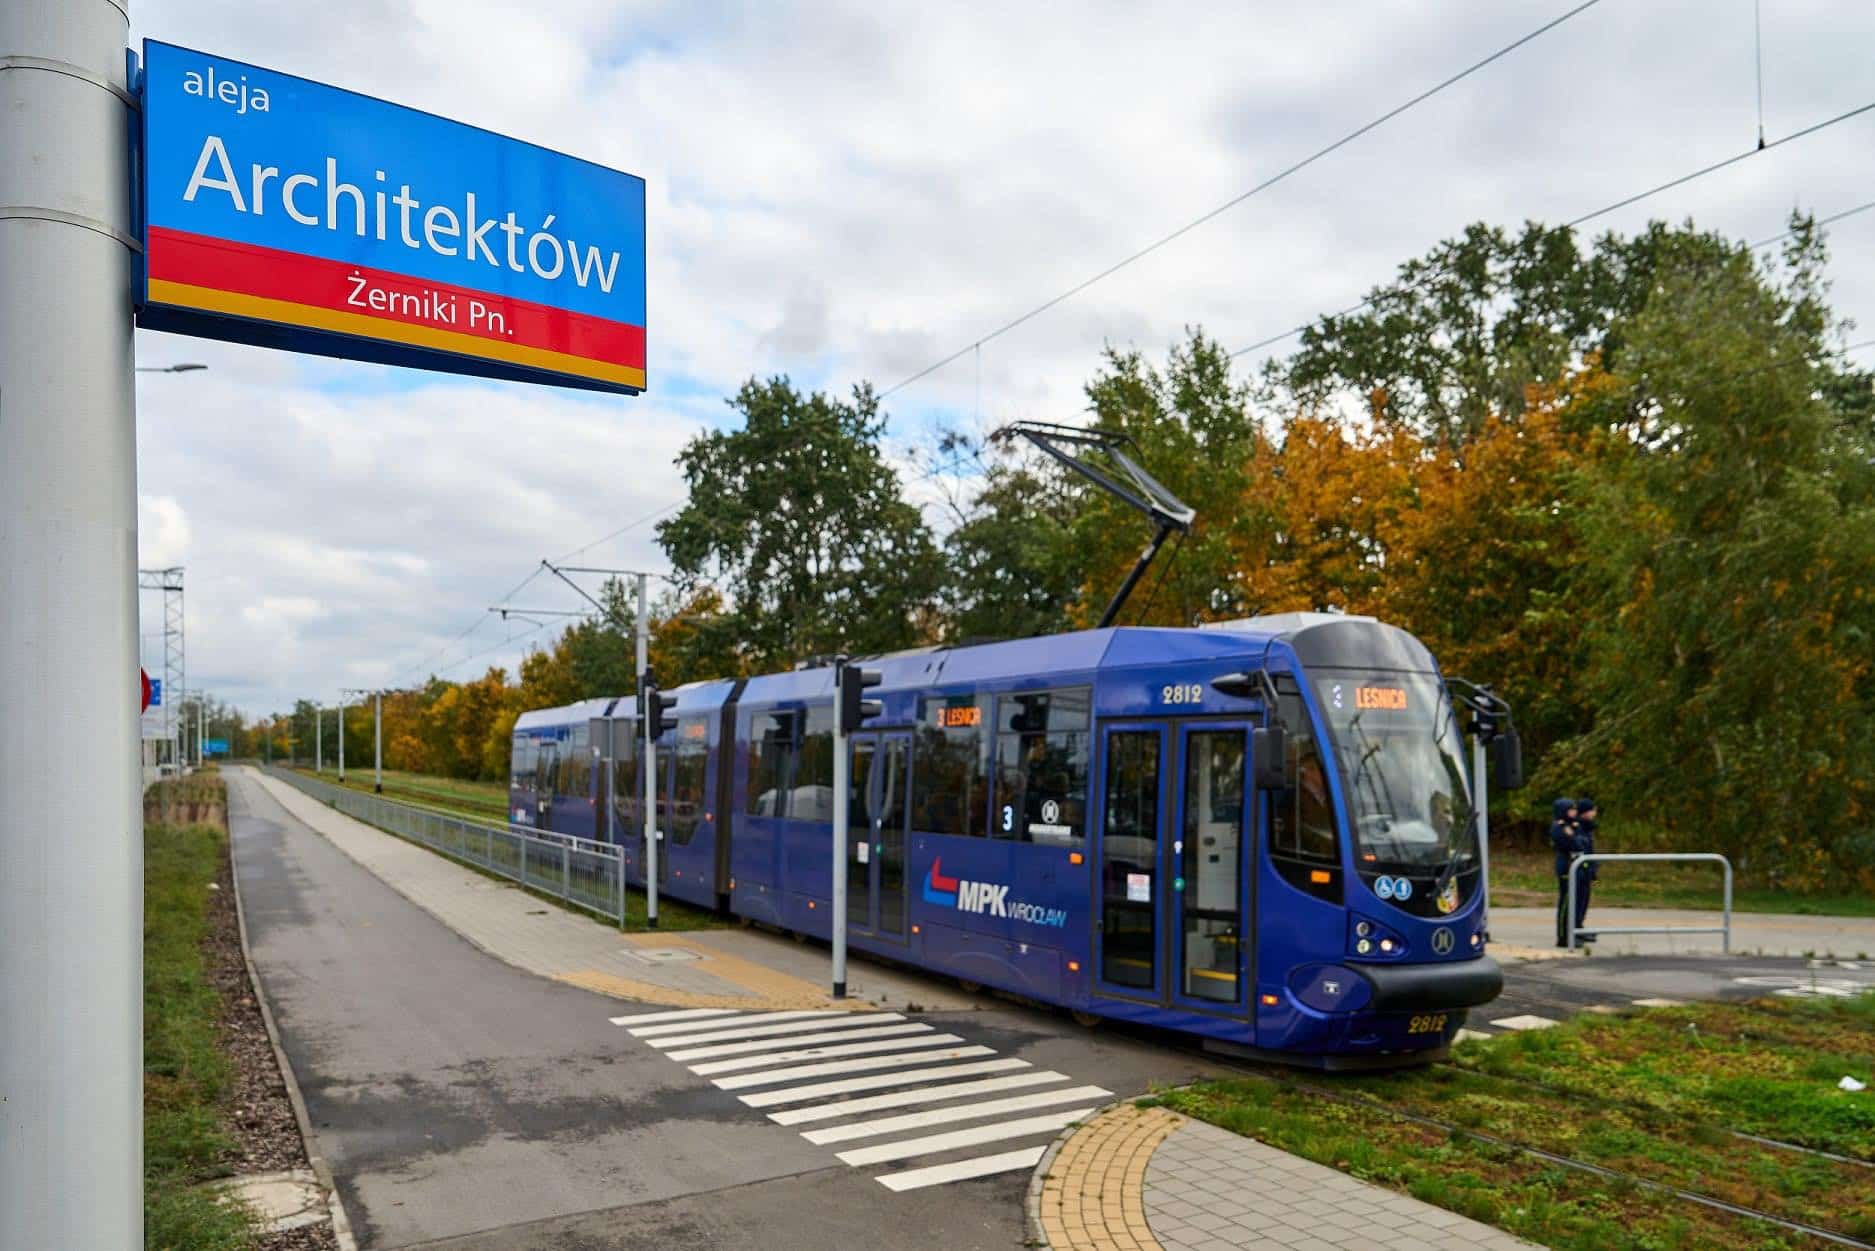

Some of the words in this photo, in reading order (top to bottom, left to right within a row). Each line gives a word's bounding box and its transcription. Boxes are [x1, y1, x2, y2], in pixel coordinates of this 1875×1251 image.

[183, 67, 270, 114] aleja
[183, 135, 621, 294] Architektów
[346, 271, 457, 325] Żerniki
[469, 300, 514, 336] Pn.
[1163, 684, 1202, 704] 2812
[1002, 805, 1013, 831] 3
[957, 880, 1009, 917] MPK
[1408, 1014, 1447, 1034] 2812
